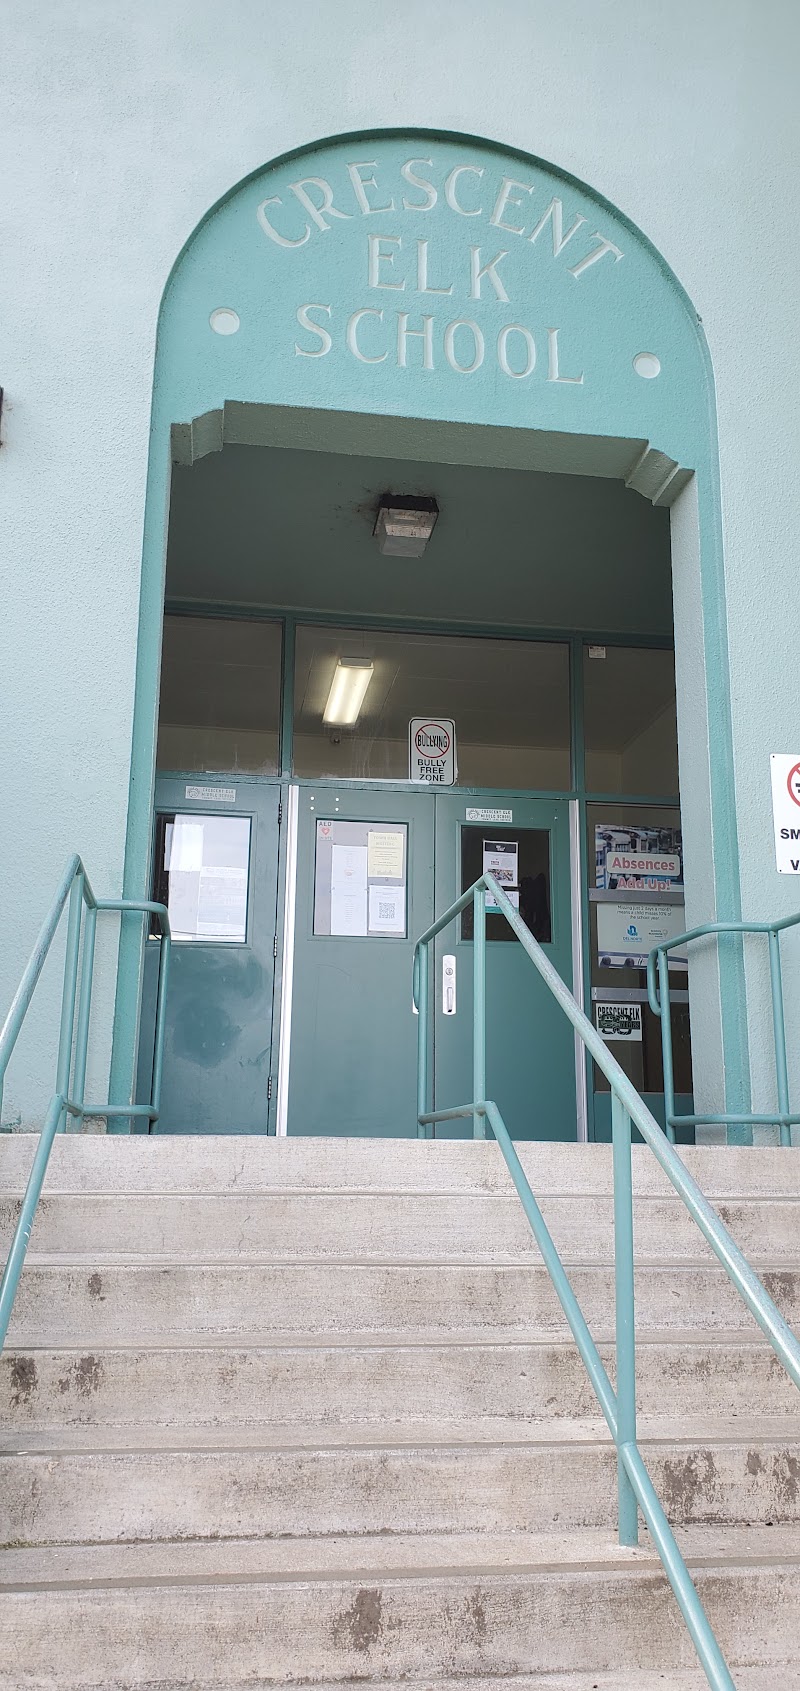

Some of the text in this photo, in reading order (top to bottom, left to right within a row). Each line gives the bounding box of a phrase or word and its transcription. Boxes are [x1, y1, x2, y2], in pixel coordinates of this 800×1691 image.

[256, 157, 625, 279] CRESCENT
[368, 233, 511, 303] ELK
[294, 303, 585, 386] SCHOOL
[417, 734, 448, 748] BULLYING
[417, 758, 447, 767] BULLY
[420, 766, 445, 775] FREE
[419, 774, 446, 782] ZONE
[612, 857, 675, 871] Absences
[790, 859, 800, 871] V
[617, 877, 671, 892] Add Up!
[629, 1008, 640, 1021] ELK
